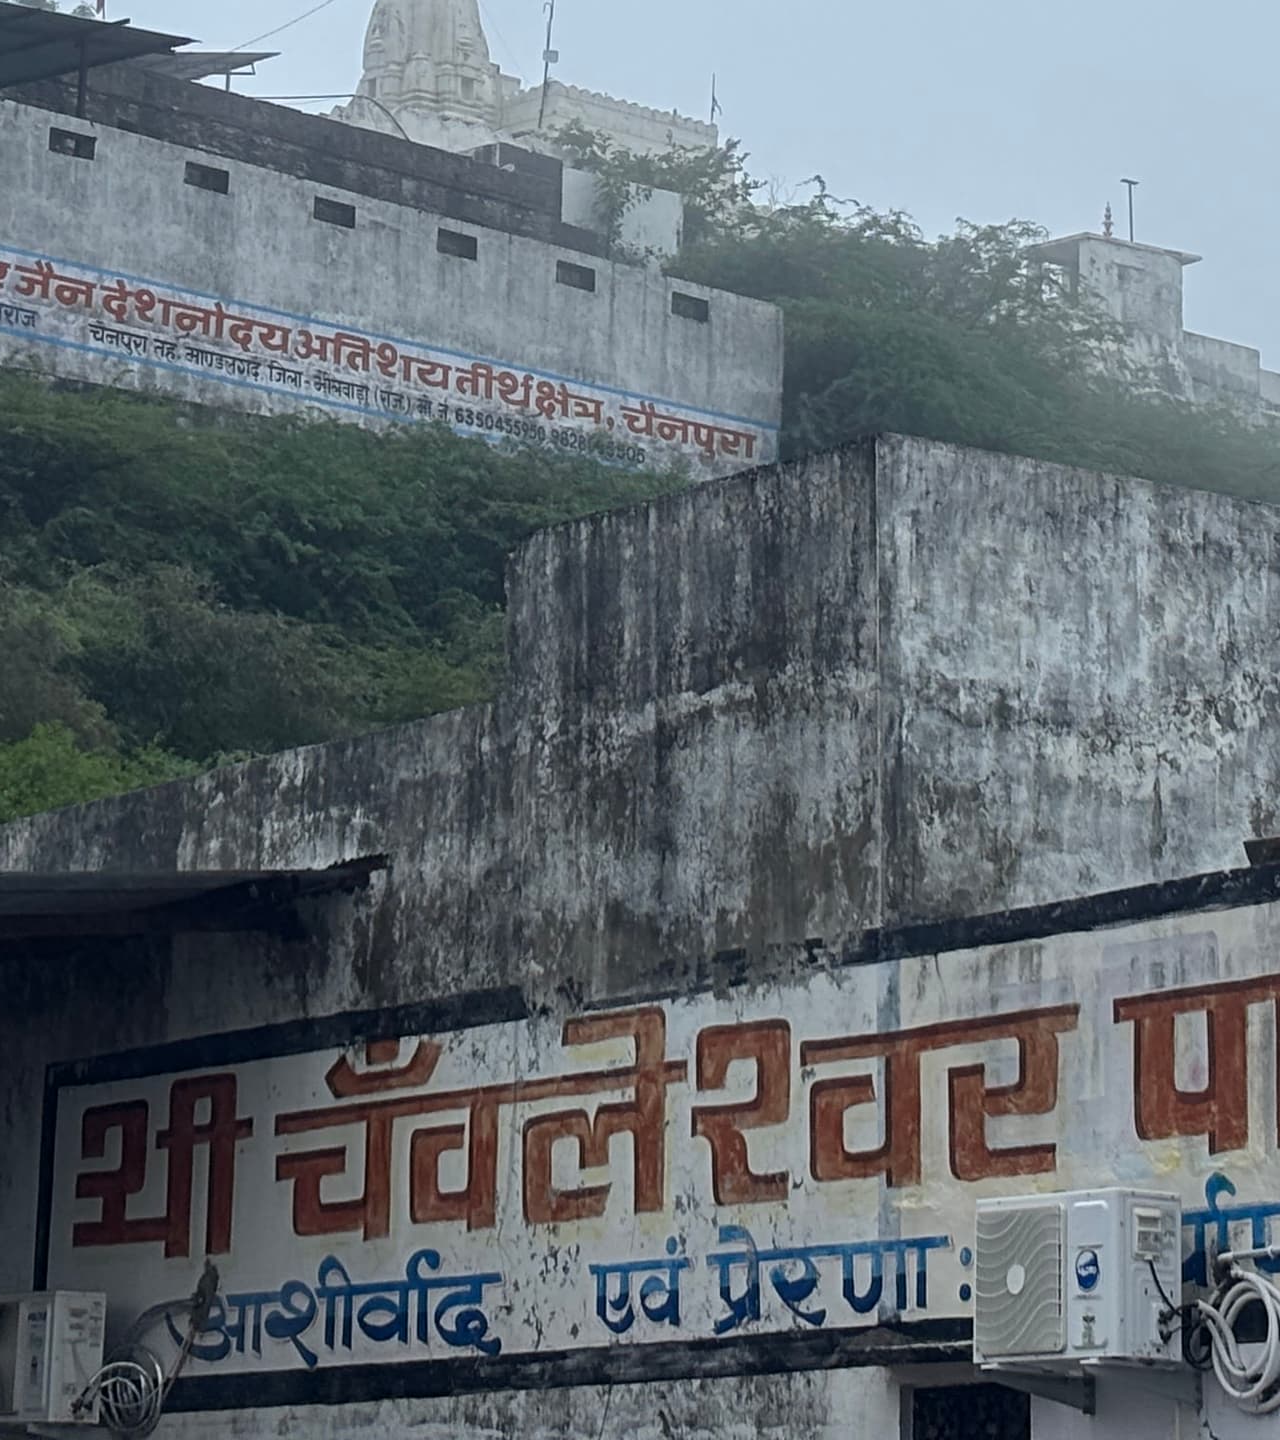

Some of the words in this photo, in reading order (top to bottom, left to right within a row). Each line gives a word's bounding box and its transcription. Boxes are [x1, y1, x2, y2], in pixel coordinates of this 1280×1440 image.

[14, 260, 96, 309] जैन
[100, 279, 292, 355] देशनोदय
[295, 329, 452, 390] अतिशय
[620, 401, 757, 462] चैनपुरा
[72, 1071, 253, 1258] श्री
[167, 1247, 504, 1368] आशीर्वाद
[588, 1235, 691, 1334] एवं
